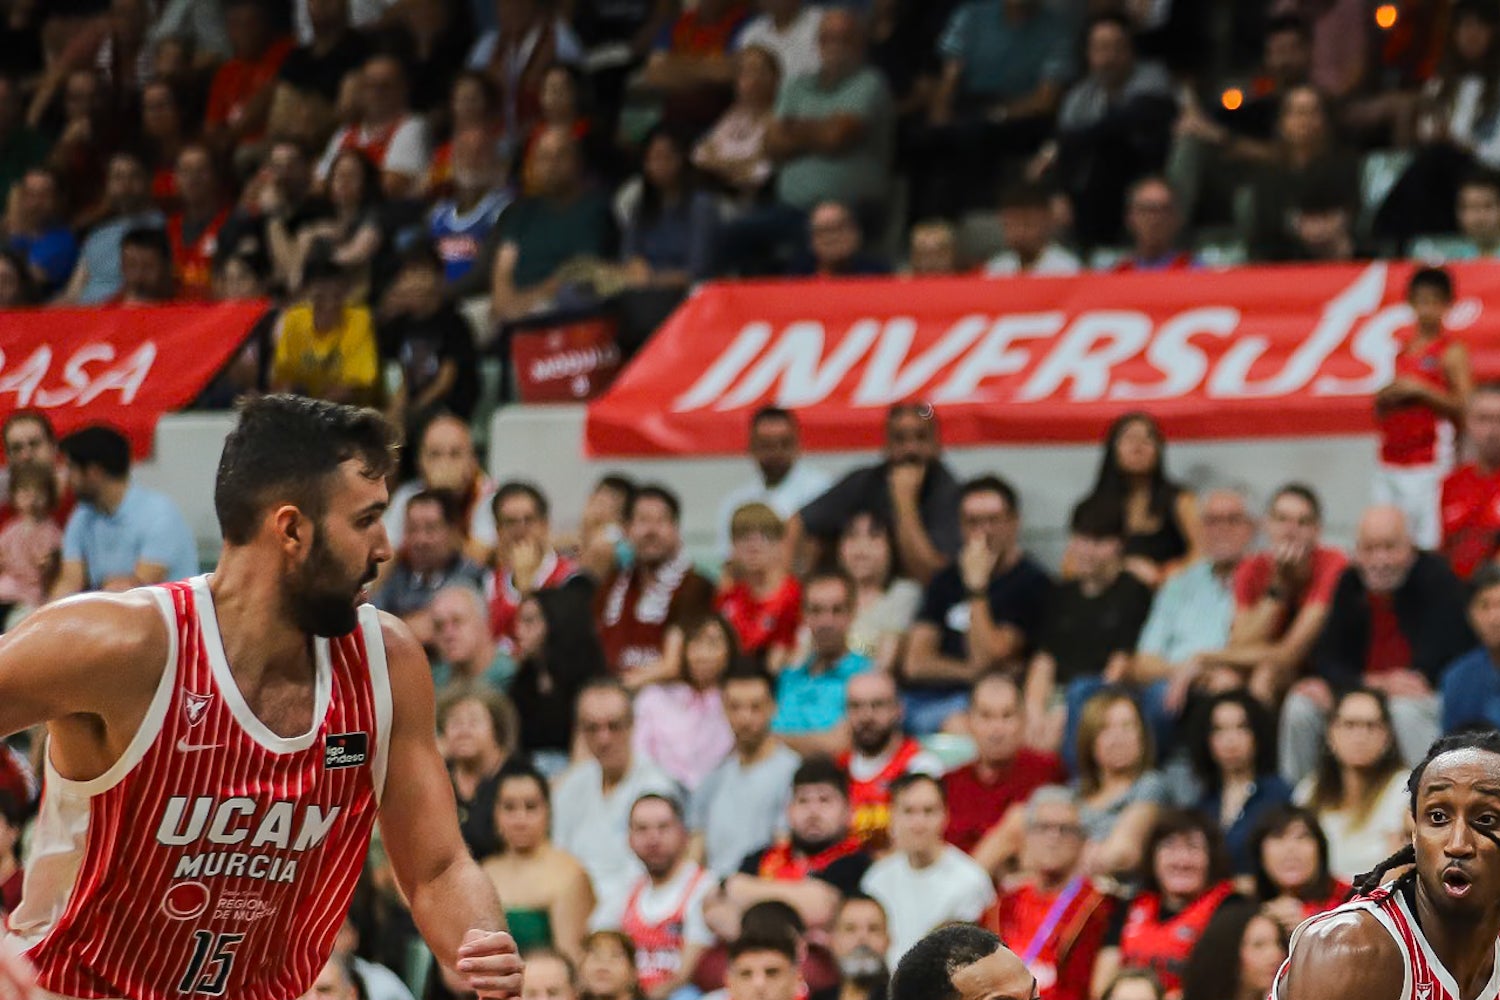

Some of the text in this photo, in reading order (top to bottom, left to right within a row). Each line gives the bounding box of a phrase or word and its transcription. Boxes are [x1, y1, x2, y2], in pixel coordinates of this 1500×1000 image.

[673, 260, 1442, 412] INVERSUS
[0, 341, 157, 408] ASA
[155, 796, 342, 852] UCAM
[173, 852, 298, 883] MURCIA
[213, 910, 231, 920] DE
[177, 929, 247, 997] 15
